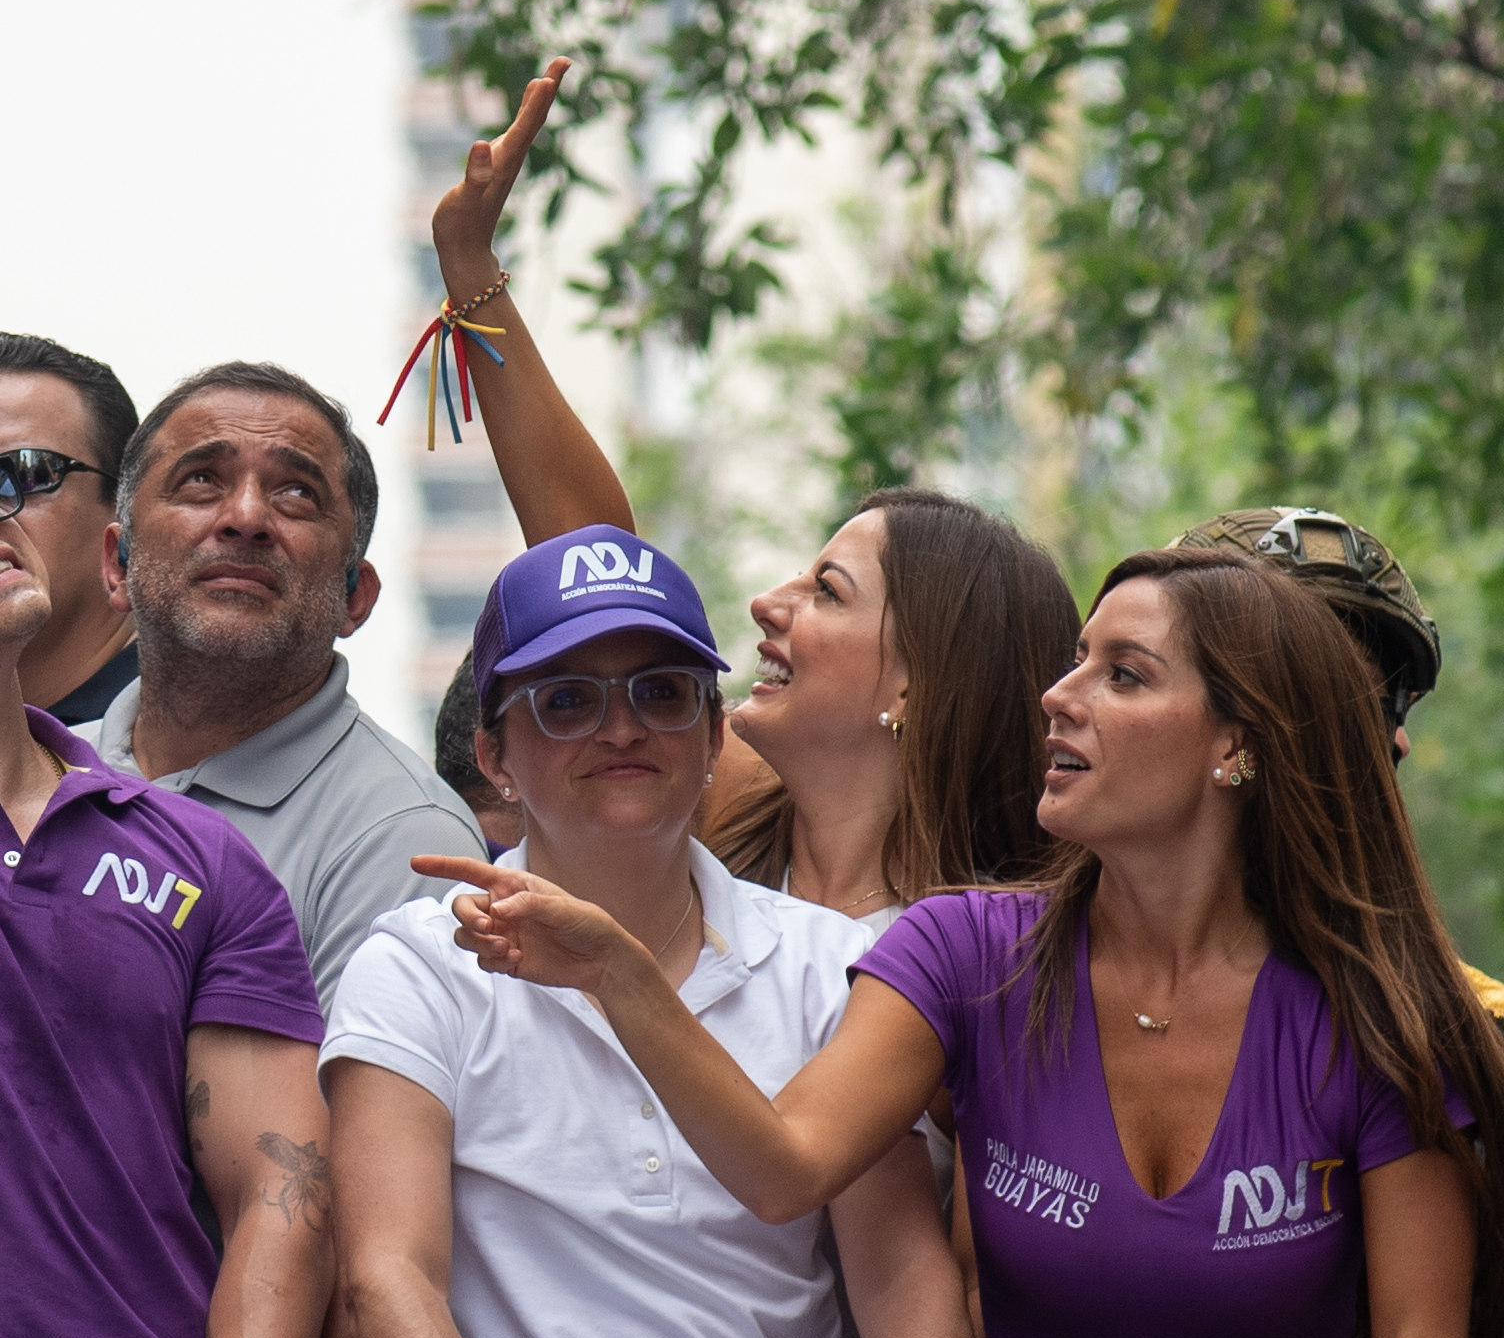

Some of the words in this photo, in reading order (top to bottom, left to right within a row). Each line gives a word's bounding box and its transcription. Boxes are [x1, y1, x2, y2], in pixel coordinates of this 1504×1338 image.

[561, 587, 587, 601] ACCIÓN
[986, 1137, 1018, 1171] PAOLA
[1020, 1153, 1100, 1203] JARAMILLO
[984, 1161, 1090, 1229] GUAYAS
[1212, 1232, 1250, 1251] ACCIÓN
[1252, 1222, 1314, 1247] DEMOCRÁTICA
